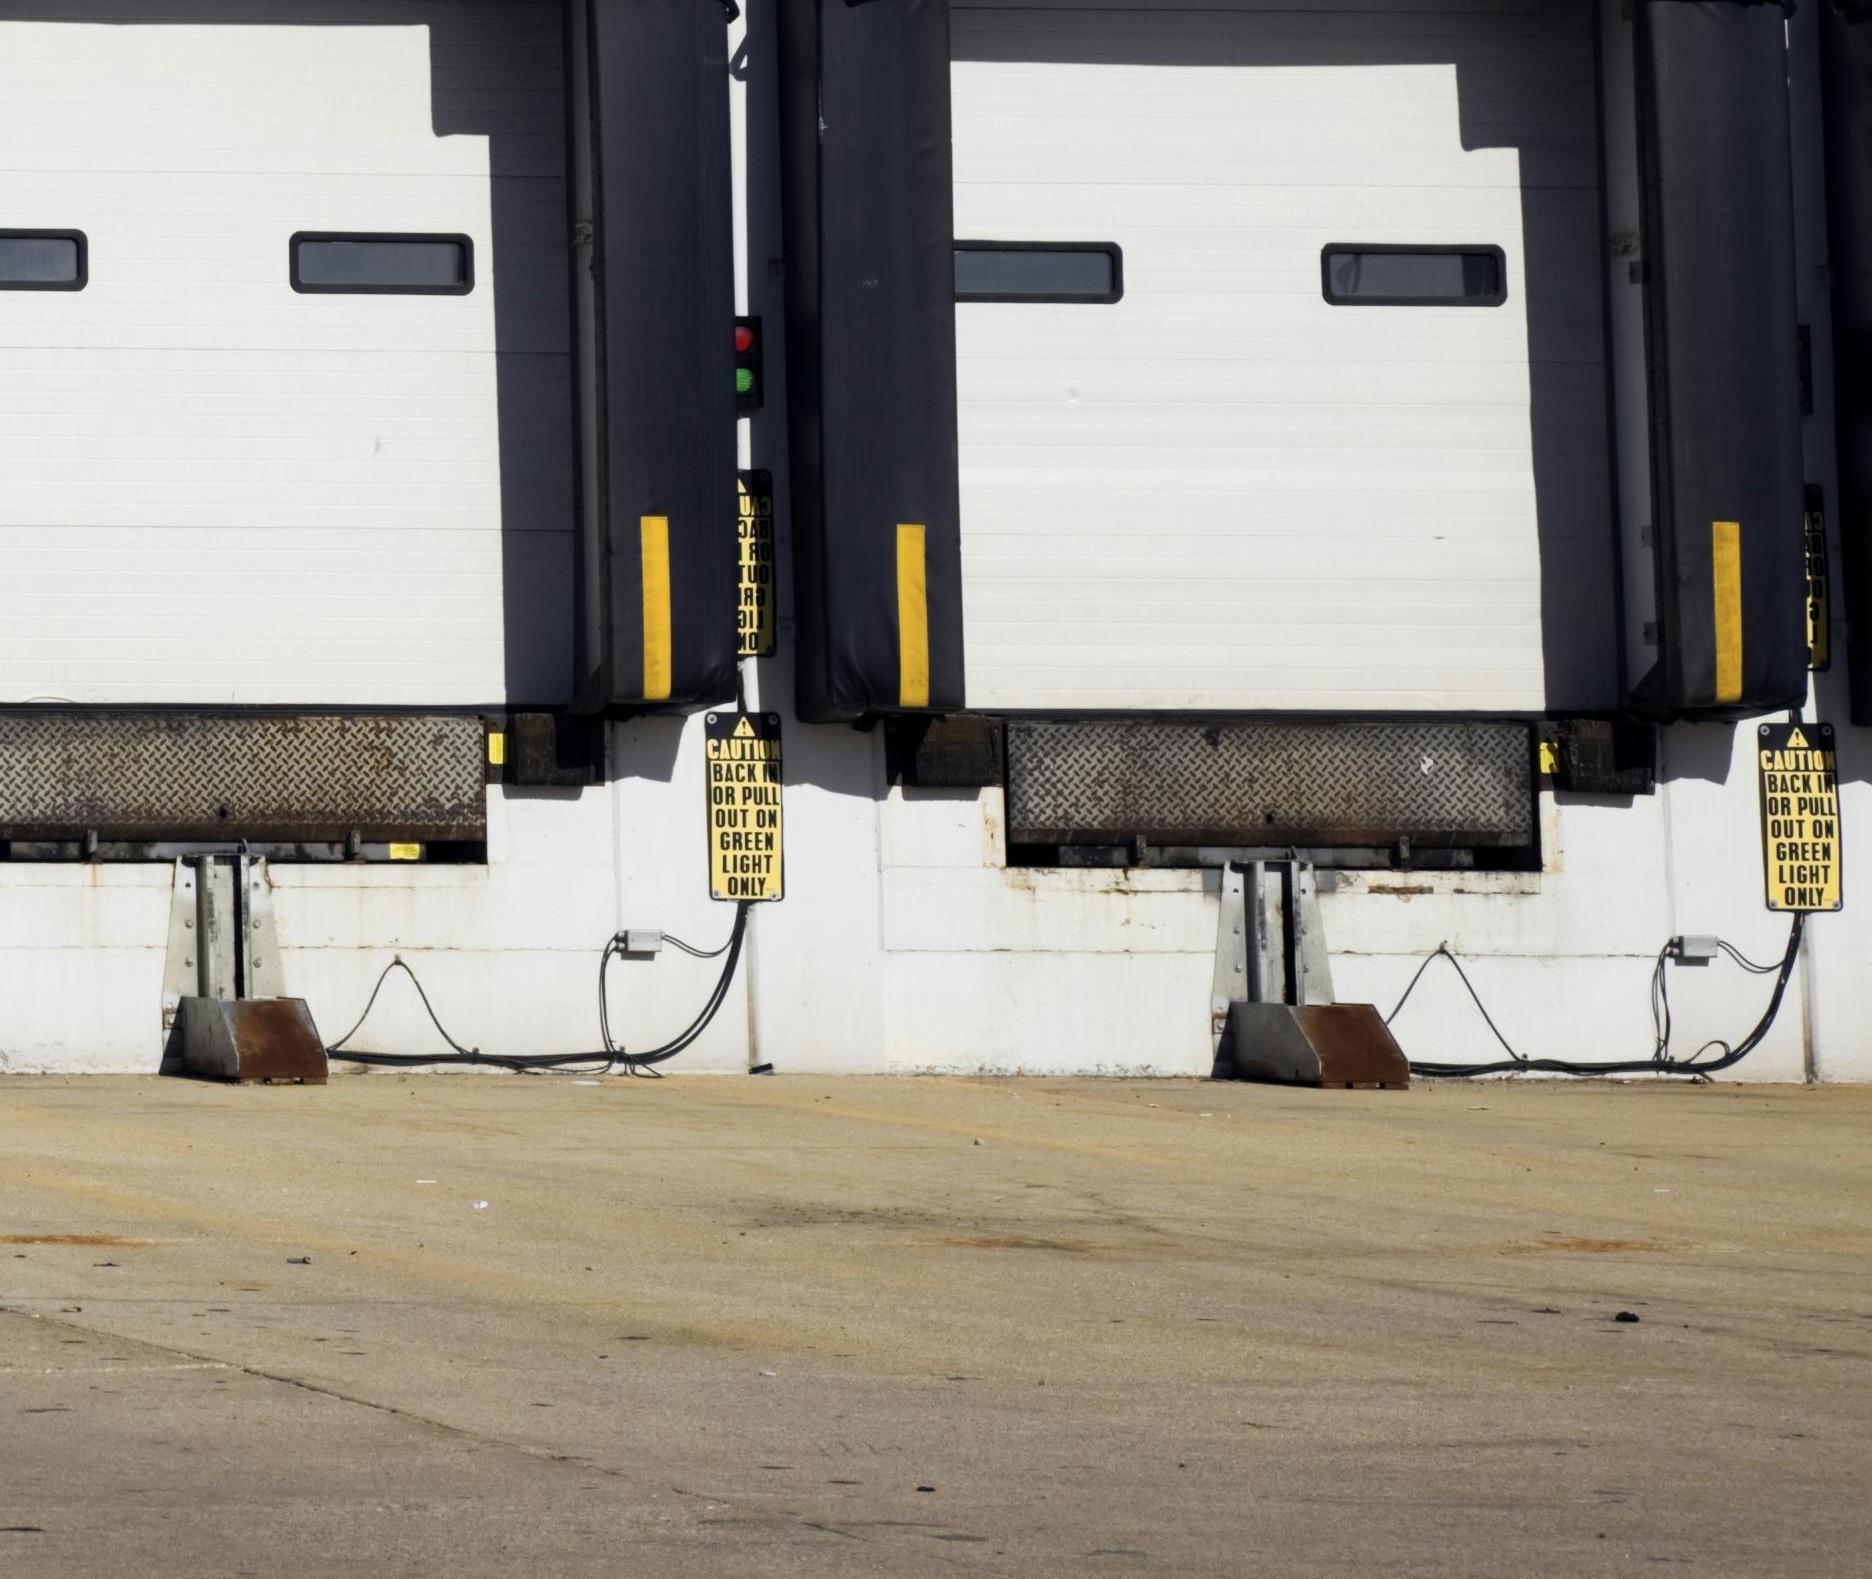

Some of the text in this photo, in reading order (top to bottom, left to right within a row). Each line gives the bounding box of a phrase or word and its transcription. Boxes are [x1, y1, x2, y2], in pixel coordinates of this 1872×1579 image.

[707, 739, 781, 760] CAUTION
[1760, 749, 1835, 771] CAUTION
[713, 763, 778, 783] BACK IN
[1767, 774, 1834, 794] BACK IN
[713, 786, 780, 806] OR PULL
[1768, 796, 1836, 816] OR PULL
[715, 809, 777, 829] OUT ON
[1771, 819, 1834, 839] OUT ON
[720, 832, 774, 851] GREEN
[1776, 842, 1831, 862] GREEN
[722, 854, 773, 874] LIGHT
[1779, 865, 1831, 884] LIGHT
[727, 877, 766, 896] ONLY
[1784, 887, 1824, 907] ONLY
